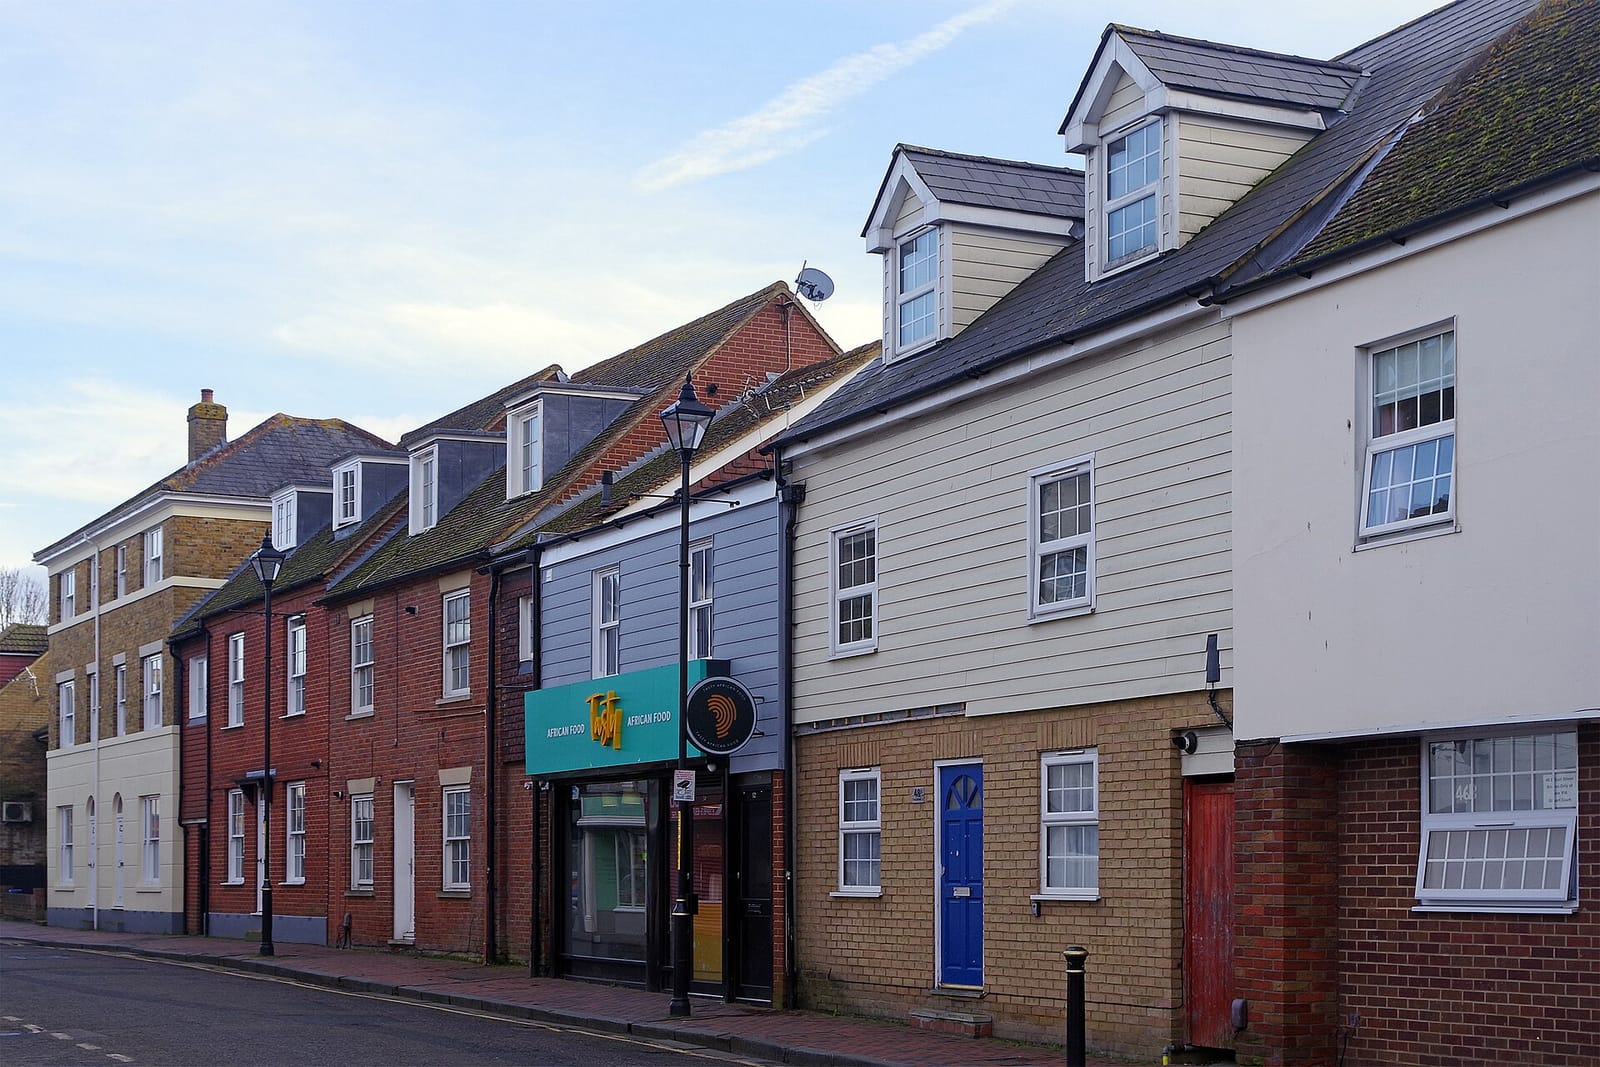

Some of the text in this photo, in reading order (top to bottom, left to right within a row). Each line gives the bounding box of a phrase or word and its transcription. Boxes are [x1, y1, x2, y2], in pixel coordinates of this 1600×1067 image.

[585, 690, 623, 750] Tasty
[627, 711, 671, 727] AFRICAN FOOD
[546, 723, 585, 738] AFRICAN FOOD
